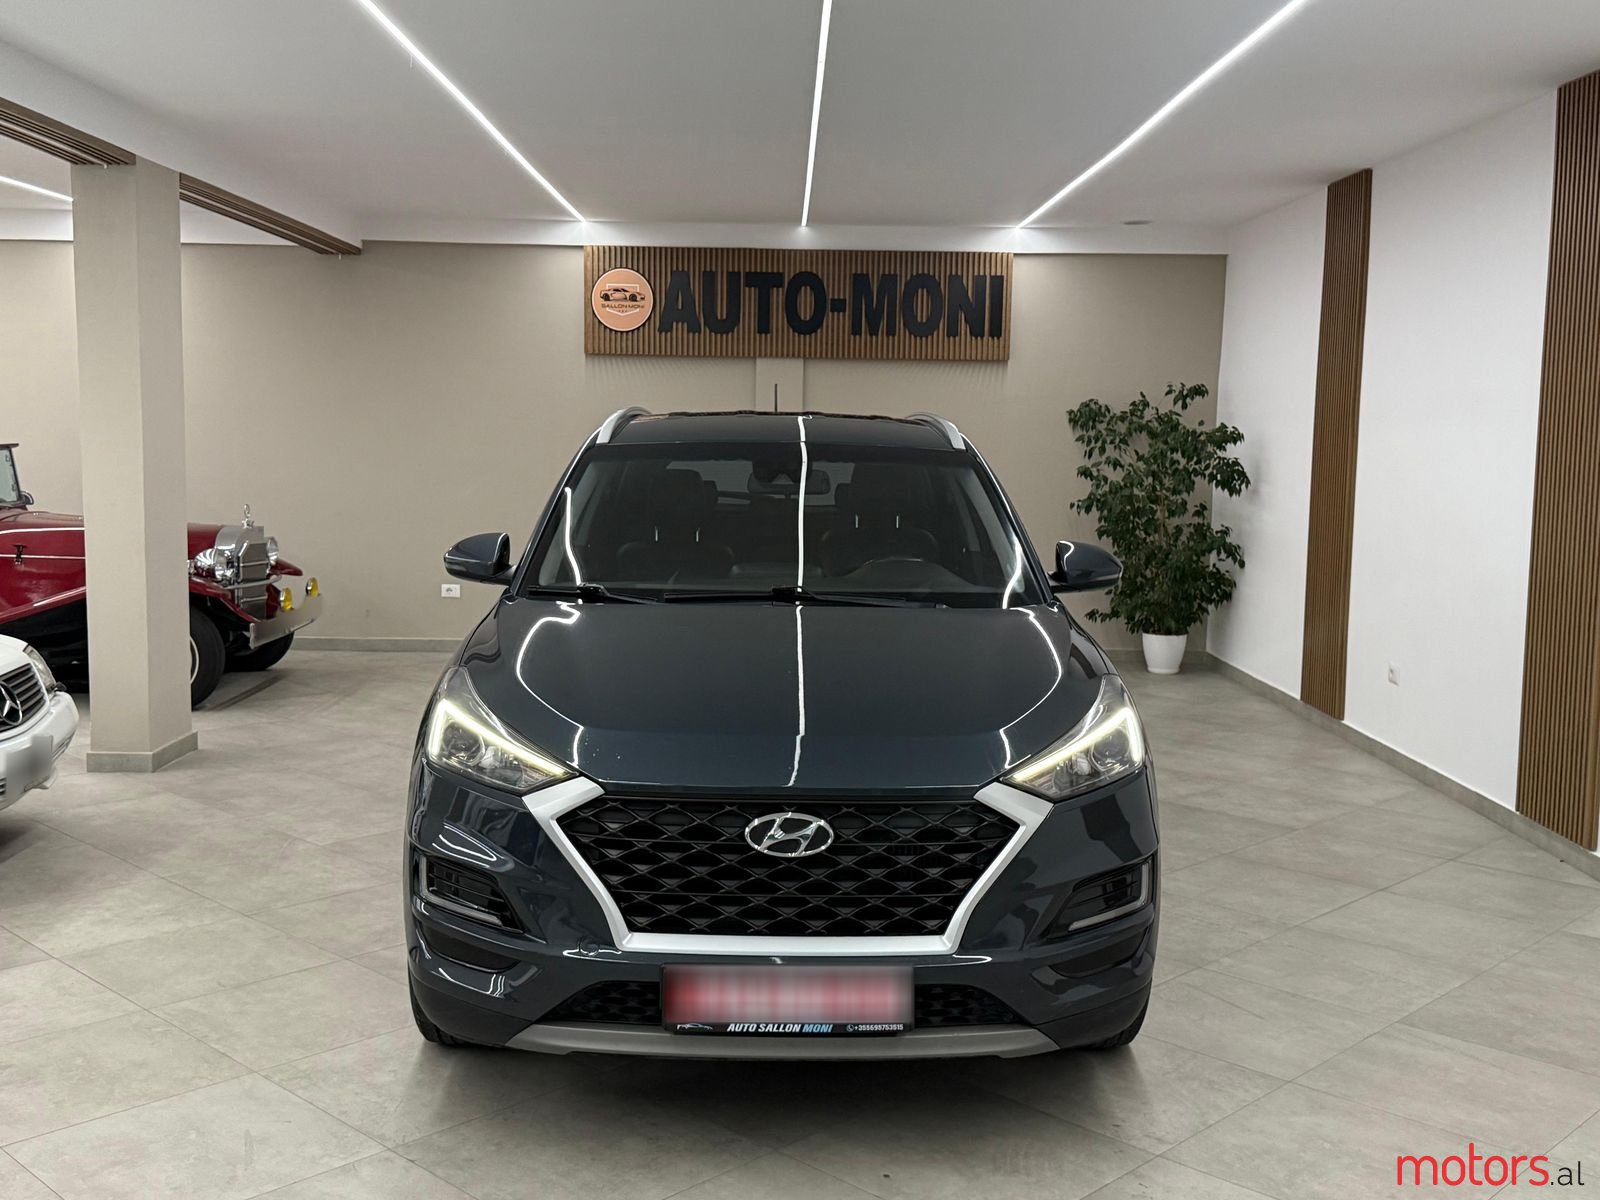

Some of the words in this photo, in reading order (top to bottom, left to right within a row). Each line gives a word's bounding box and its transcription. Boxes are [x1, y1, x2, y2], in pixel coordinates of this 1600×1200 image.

[658, 270, 1005, 339] AUTO-MONI
[727, 1023, 757, 1032] AUTO
[758, 1023, 801, 1033] SALLON
[802, 1023, 833, 1033] MONI
